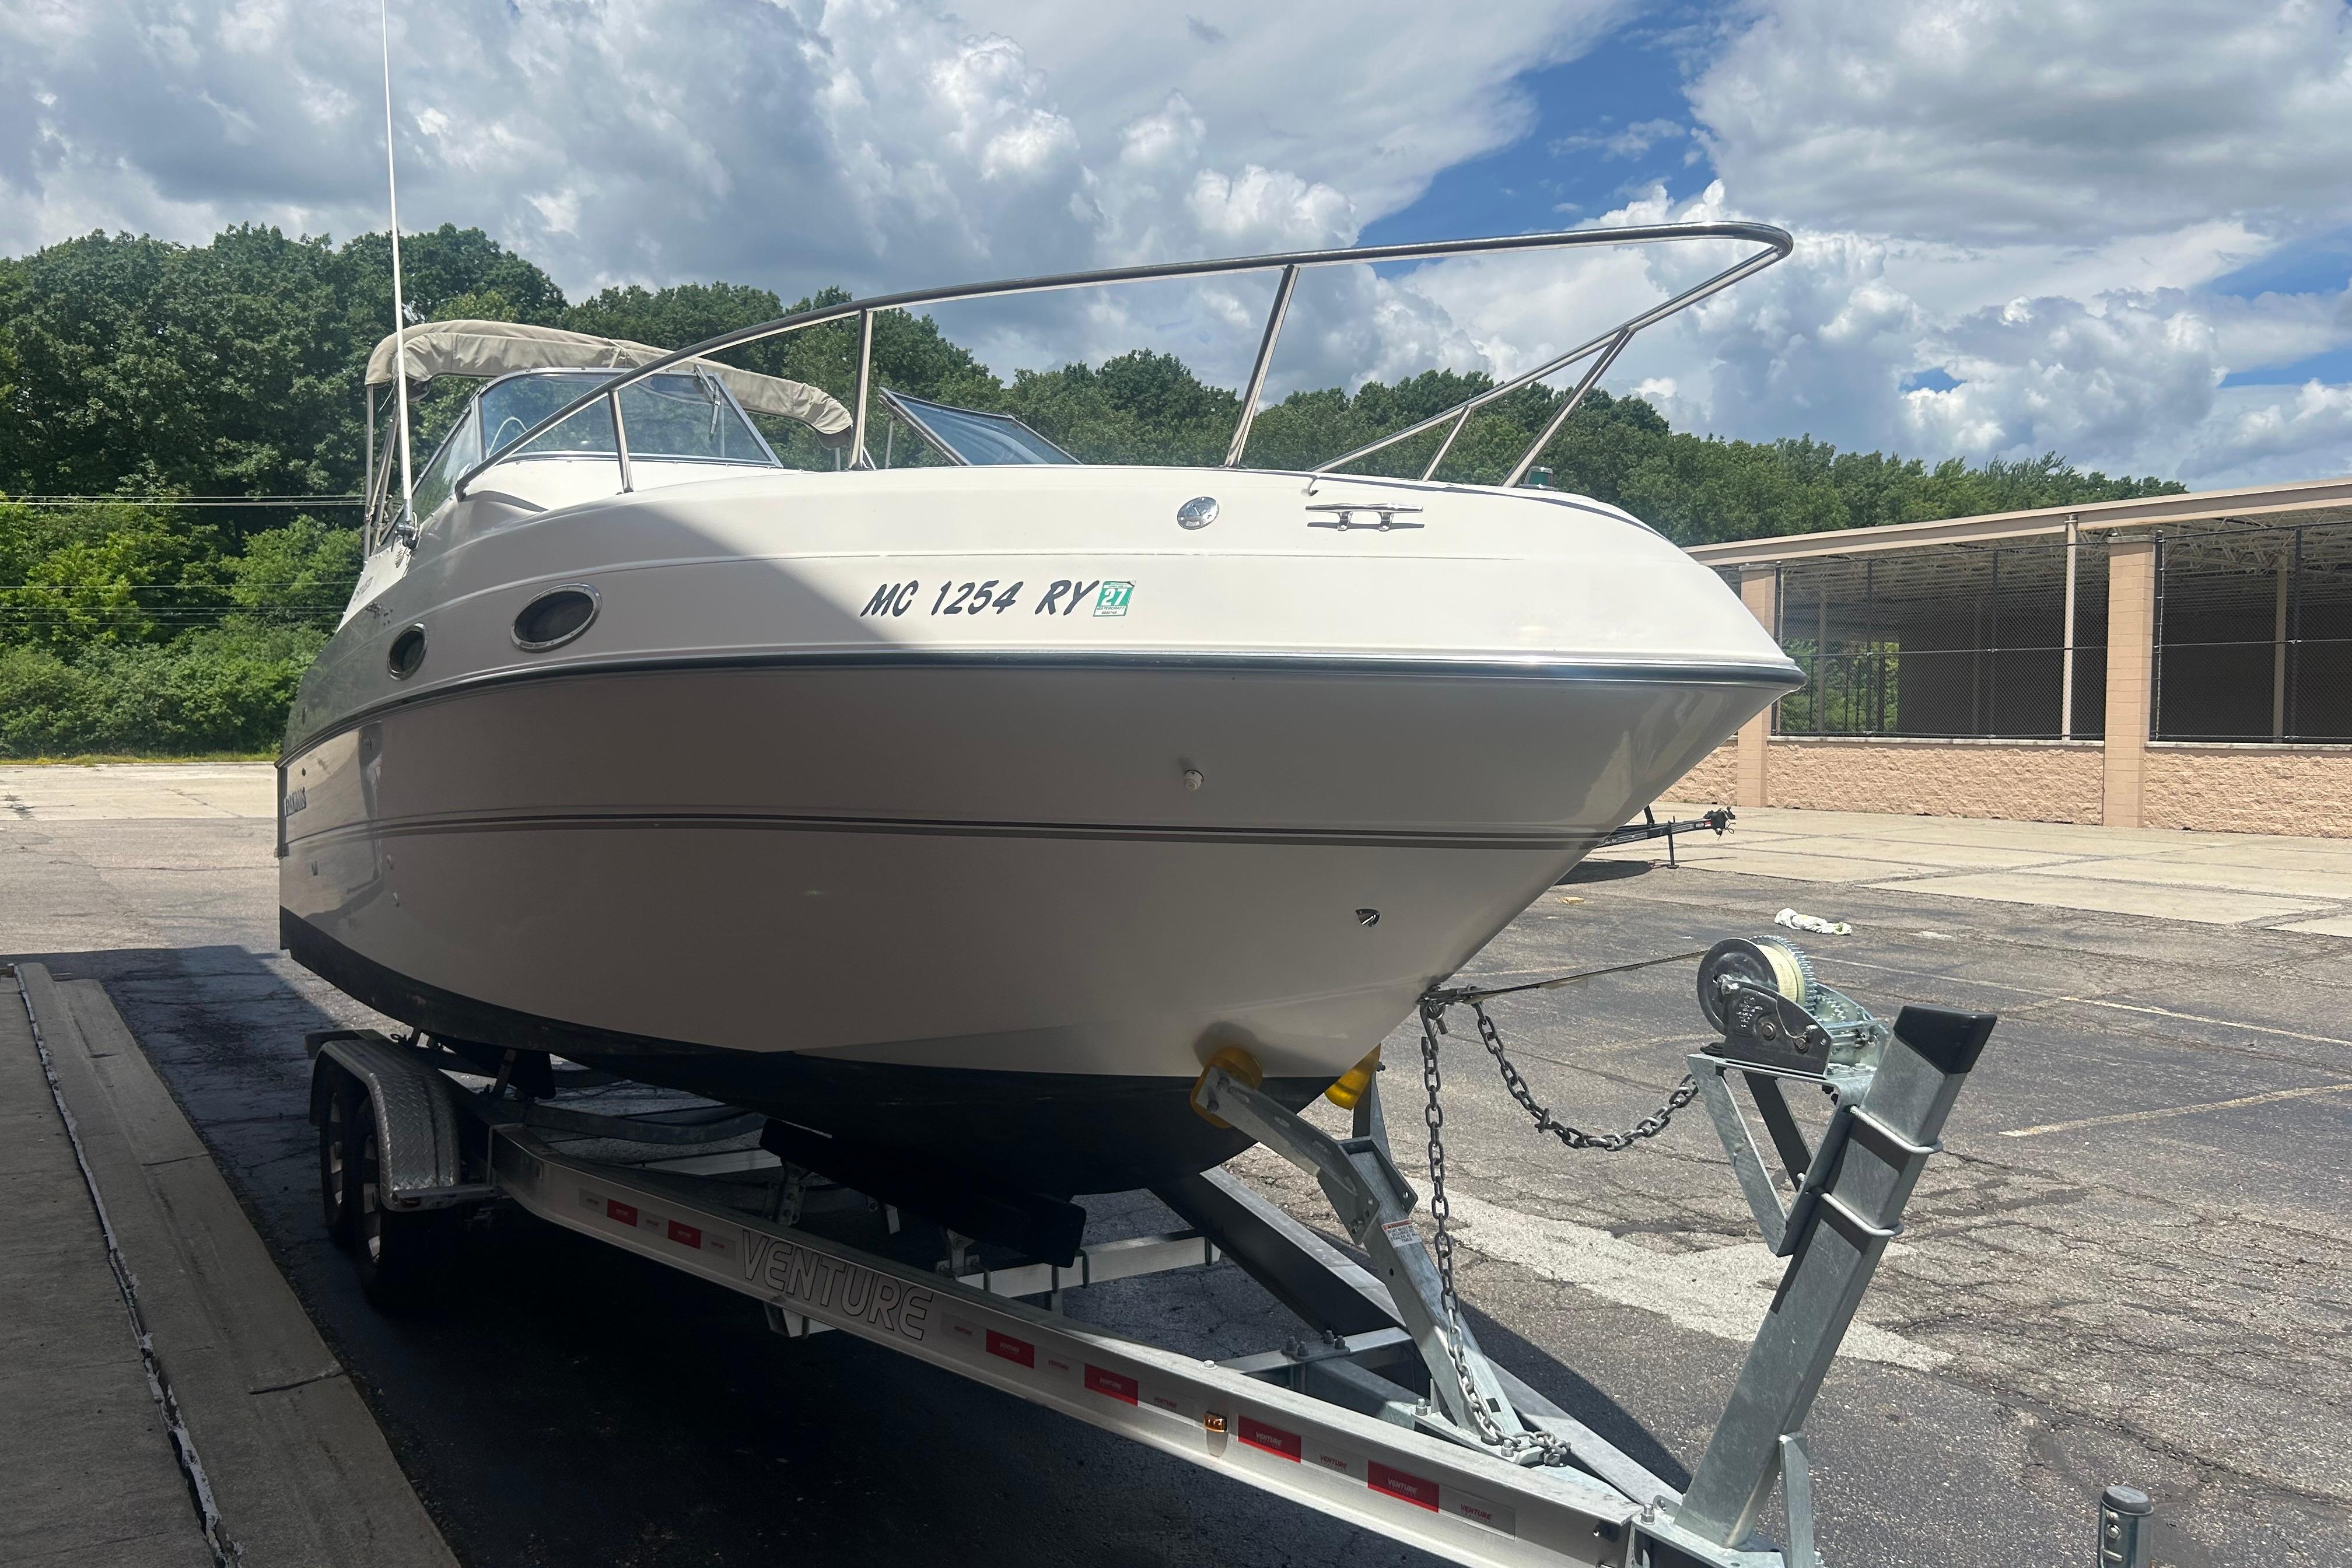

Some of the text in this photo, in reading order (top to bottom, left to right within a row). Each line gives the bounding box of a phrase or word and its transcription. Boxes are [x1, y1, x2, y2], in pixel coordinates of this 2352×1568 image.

[860, 580, 1100, 617] MC 1254 RY
[1101, 588, 1128, 606] 27
[743, 1229, 933, 1341] VENTURE
[1256, 1431, 1282, 1446] VENTURE
[1320, 1454, 1348, 1469] VENTURE
[1388, 1478, 1418, 1494] VENTURE
[1460, 1503, 1492, 1520] VENTURE
